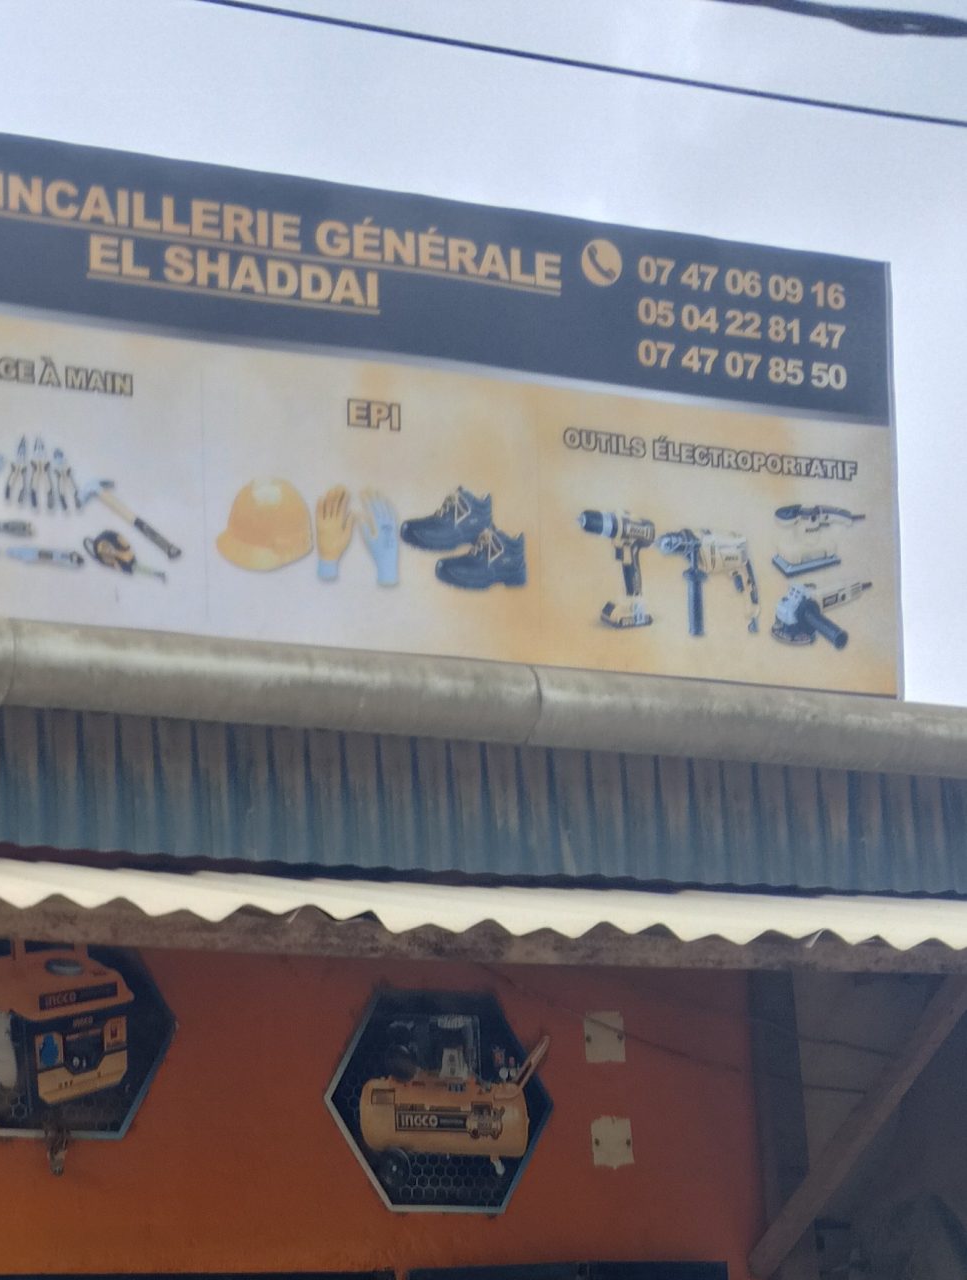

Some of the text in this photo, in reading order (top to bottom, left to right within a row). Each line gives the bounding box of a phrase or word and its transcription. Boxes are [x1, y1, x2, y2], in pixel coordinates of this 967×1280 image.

[89, 235, 380, 309] EL SHADDAI
[315, 217, 561, 288] GÉNÉRALE
[638, 255, 846, 310] 07 47 06 09 16
[638, 296, 846, 349] 05 04 22 81 47
[38, 353, 61, 388] À
[65, 365, 133, 397] MAIN
[638, 339, 847, 390] 07 47 07 85 50
[347, 398, 402, 432] EPI
[563, 427, 858, 482] OUTILS ÉLECTROPORTATIF
